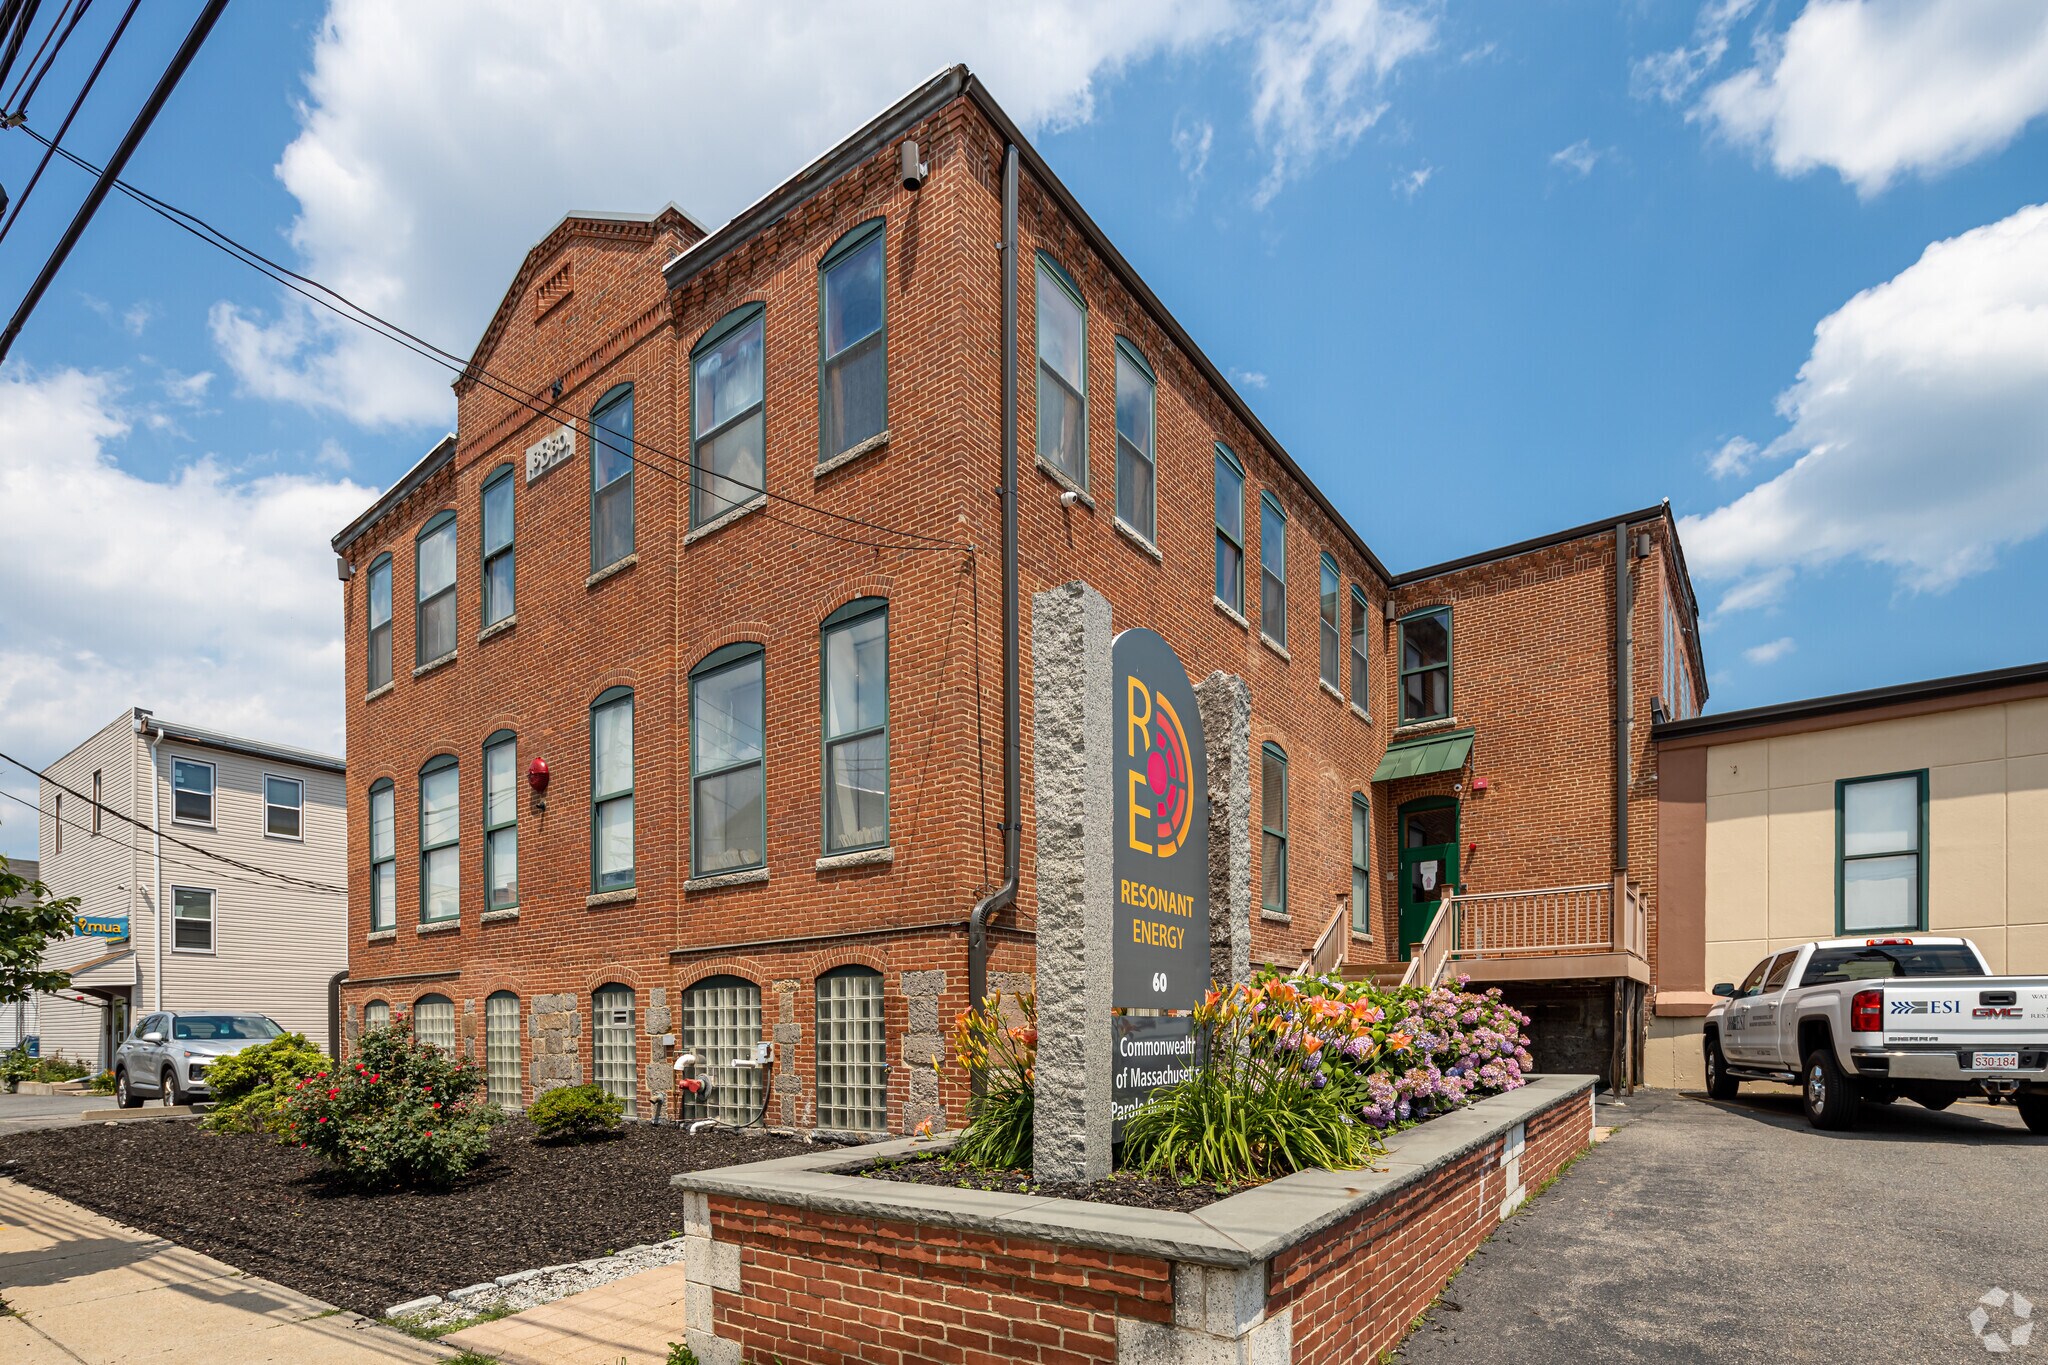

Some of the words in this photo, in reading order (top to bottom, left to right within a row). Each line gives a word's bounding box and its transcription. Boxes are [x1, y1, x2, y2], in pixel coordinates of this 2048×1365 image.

[1121, 879, 1195, 918] RESONANT
[1133, 918, 1185, 950] ENERGY
[1152, 972, 1168, 993] 60
[1930, 1000, 1961, 1014] ESI
[1972, 1007, 2024, 1018] GMC
[1116, 1066, 1128, 1089] of
[1130, 1064, 1200, 1088] Massachuset
